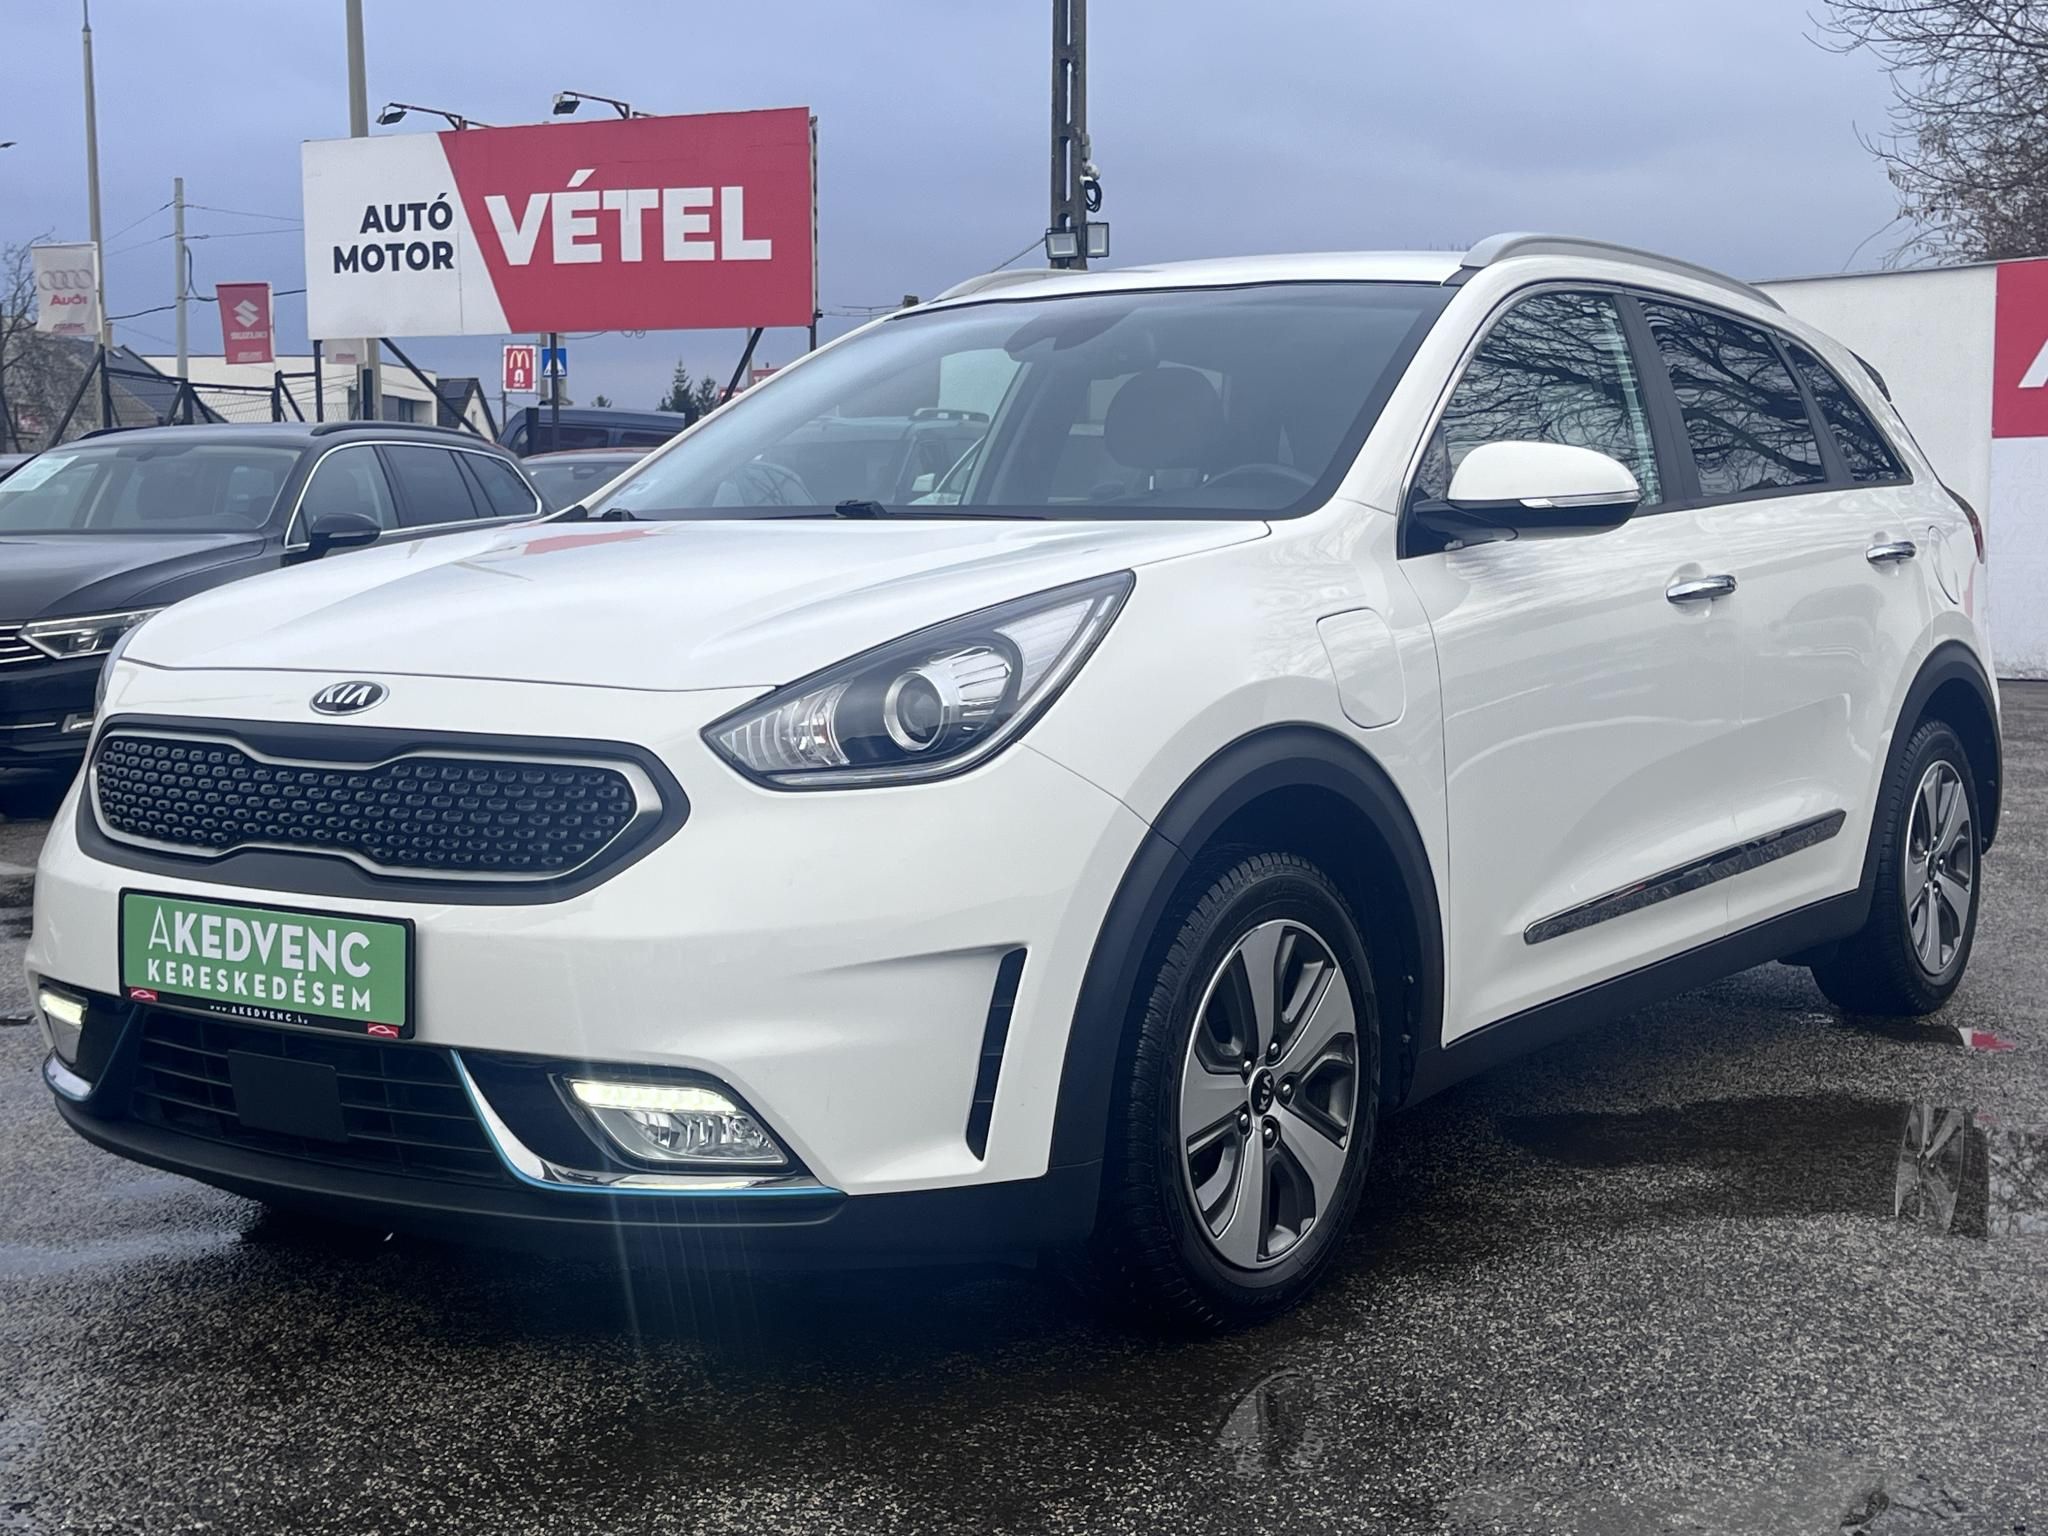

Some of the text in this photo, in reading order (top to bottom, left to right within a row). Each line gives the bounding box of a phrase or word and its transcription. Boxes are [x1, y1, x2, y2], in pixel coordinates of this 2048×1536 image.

[359, 192, 453, 234] AUTÓ
[484, 168, 772, 266] VÉTEL
[333, 241, 454, 274] MOTOR
[49, 293, 88, 306] Audi
[316, 683, 373, 706] KIA
[148, 957, 371, 1012] KERESKEDÉSEM
[1258, 1073, 1272, 1111] KIA
